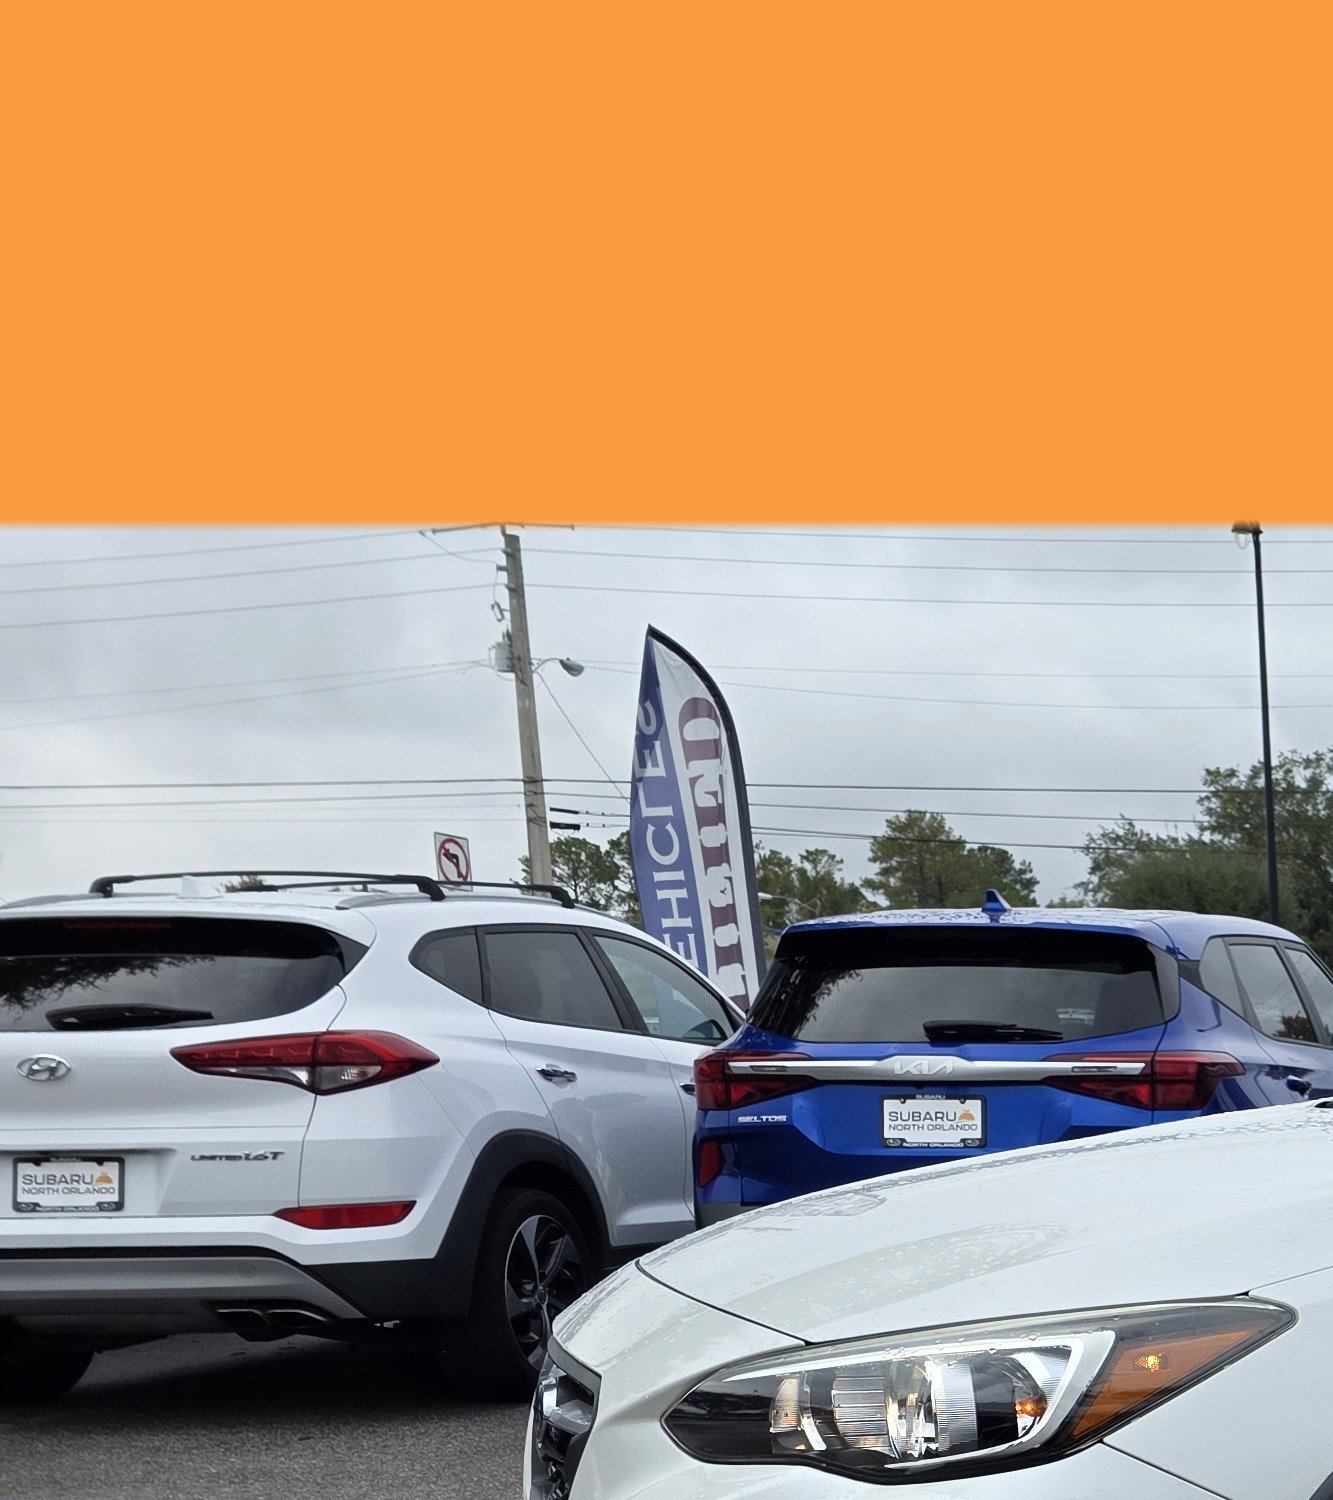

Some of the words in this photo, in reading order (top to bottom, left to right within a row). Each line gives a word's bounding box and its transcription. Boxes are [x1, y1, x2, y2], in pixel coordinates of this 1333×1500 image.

[888, 1111, 957, 1122] SUBARU
[888, 1124, 925, 1132] NORTH
[926, 1124, 978, 1132] ORLANDO
[21, 1174, 94, 1185] SUBARU
[22, 1187, 60, 1195] NORTH
[61, 1187, 116, 1195] ORLANDO
